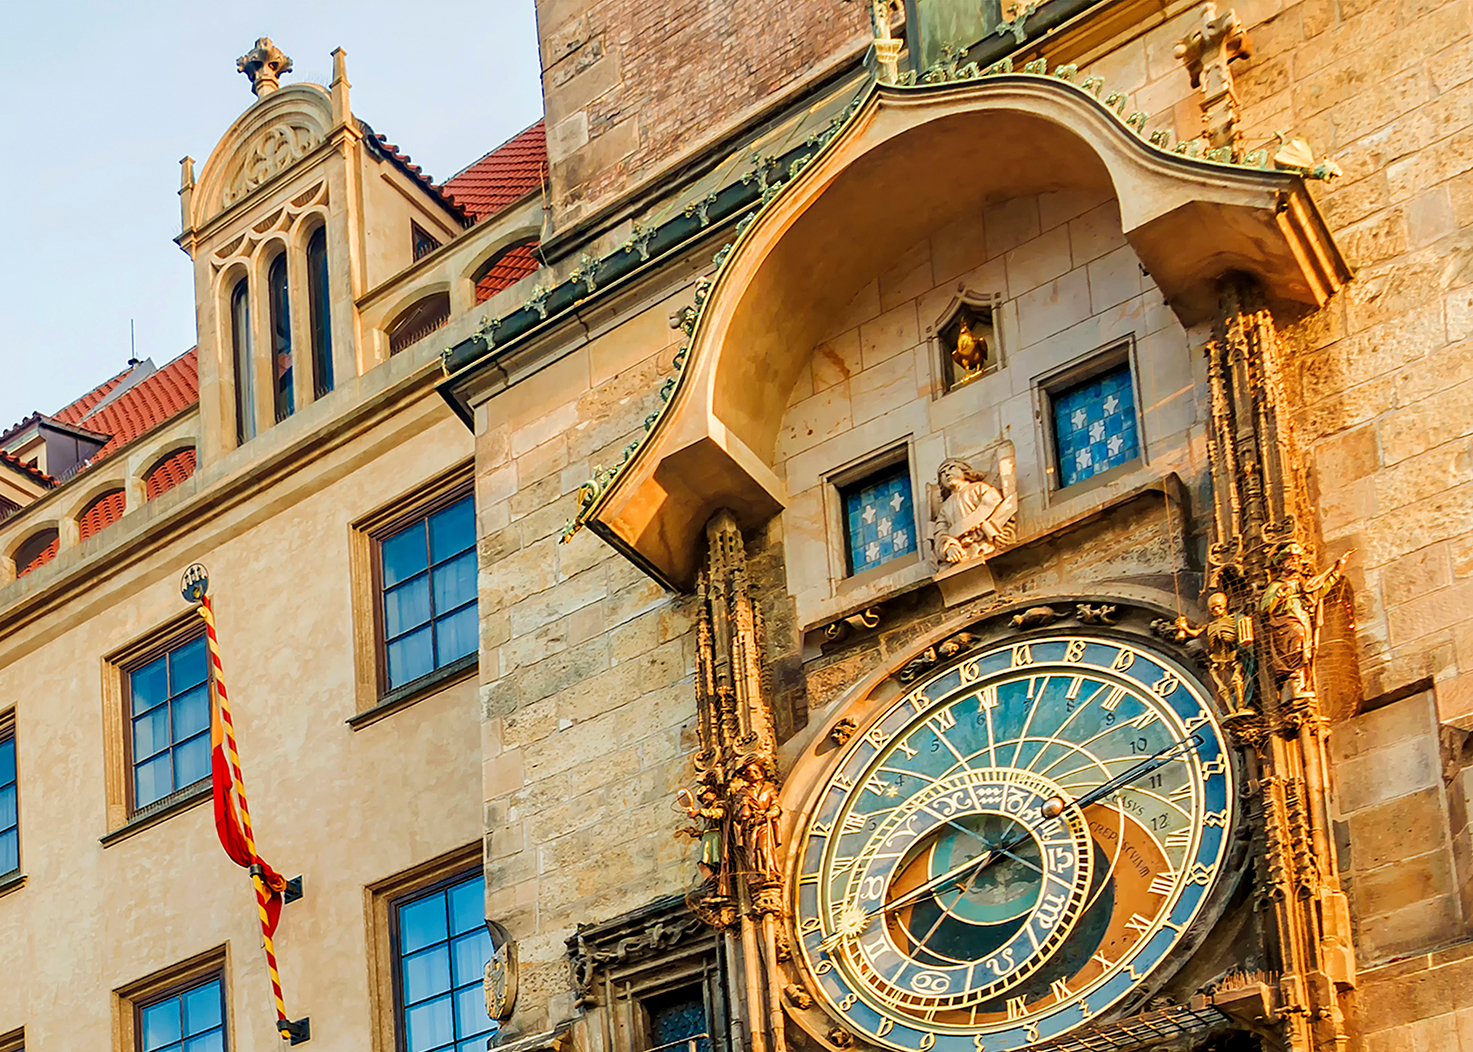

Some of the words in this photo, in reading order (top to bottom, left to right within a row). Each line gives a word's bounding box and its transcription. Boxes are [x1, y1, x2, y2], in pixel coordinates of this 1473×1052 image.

[976, 713, 986, 726] 6
[930, 738, 940, 753] 5
[1129, 738, 1147, 754] 10
[894, 775, 905, 787] 4
[1149, 773, 1162, 789] 11
[1150, 813, 1169, 832] 12
[839, 993, 858, 1011] 8
